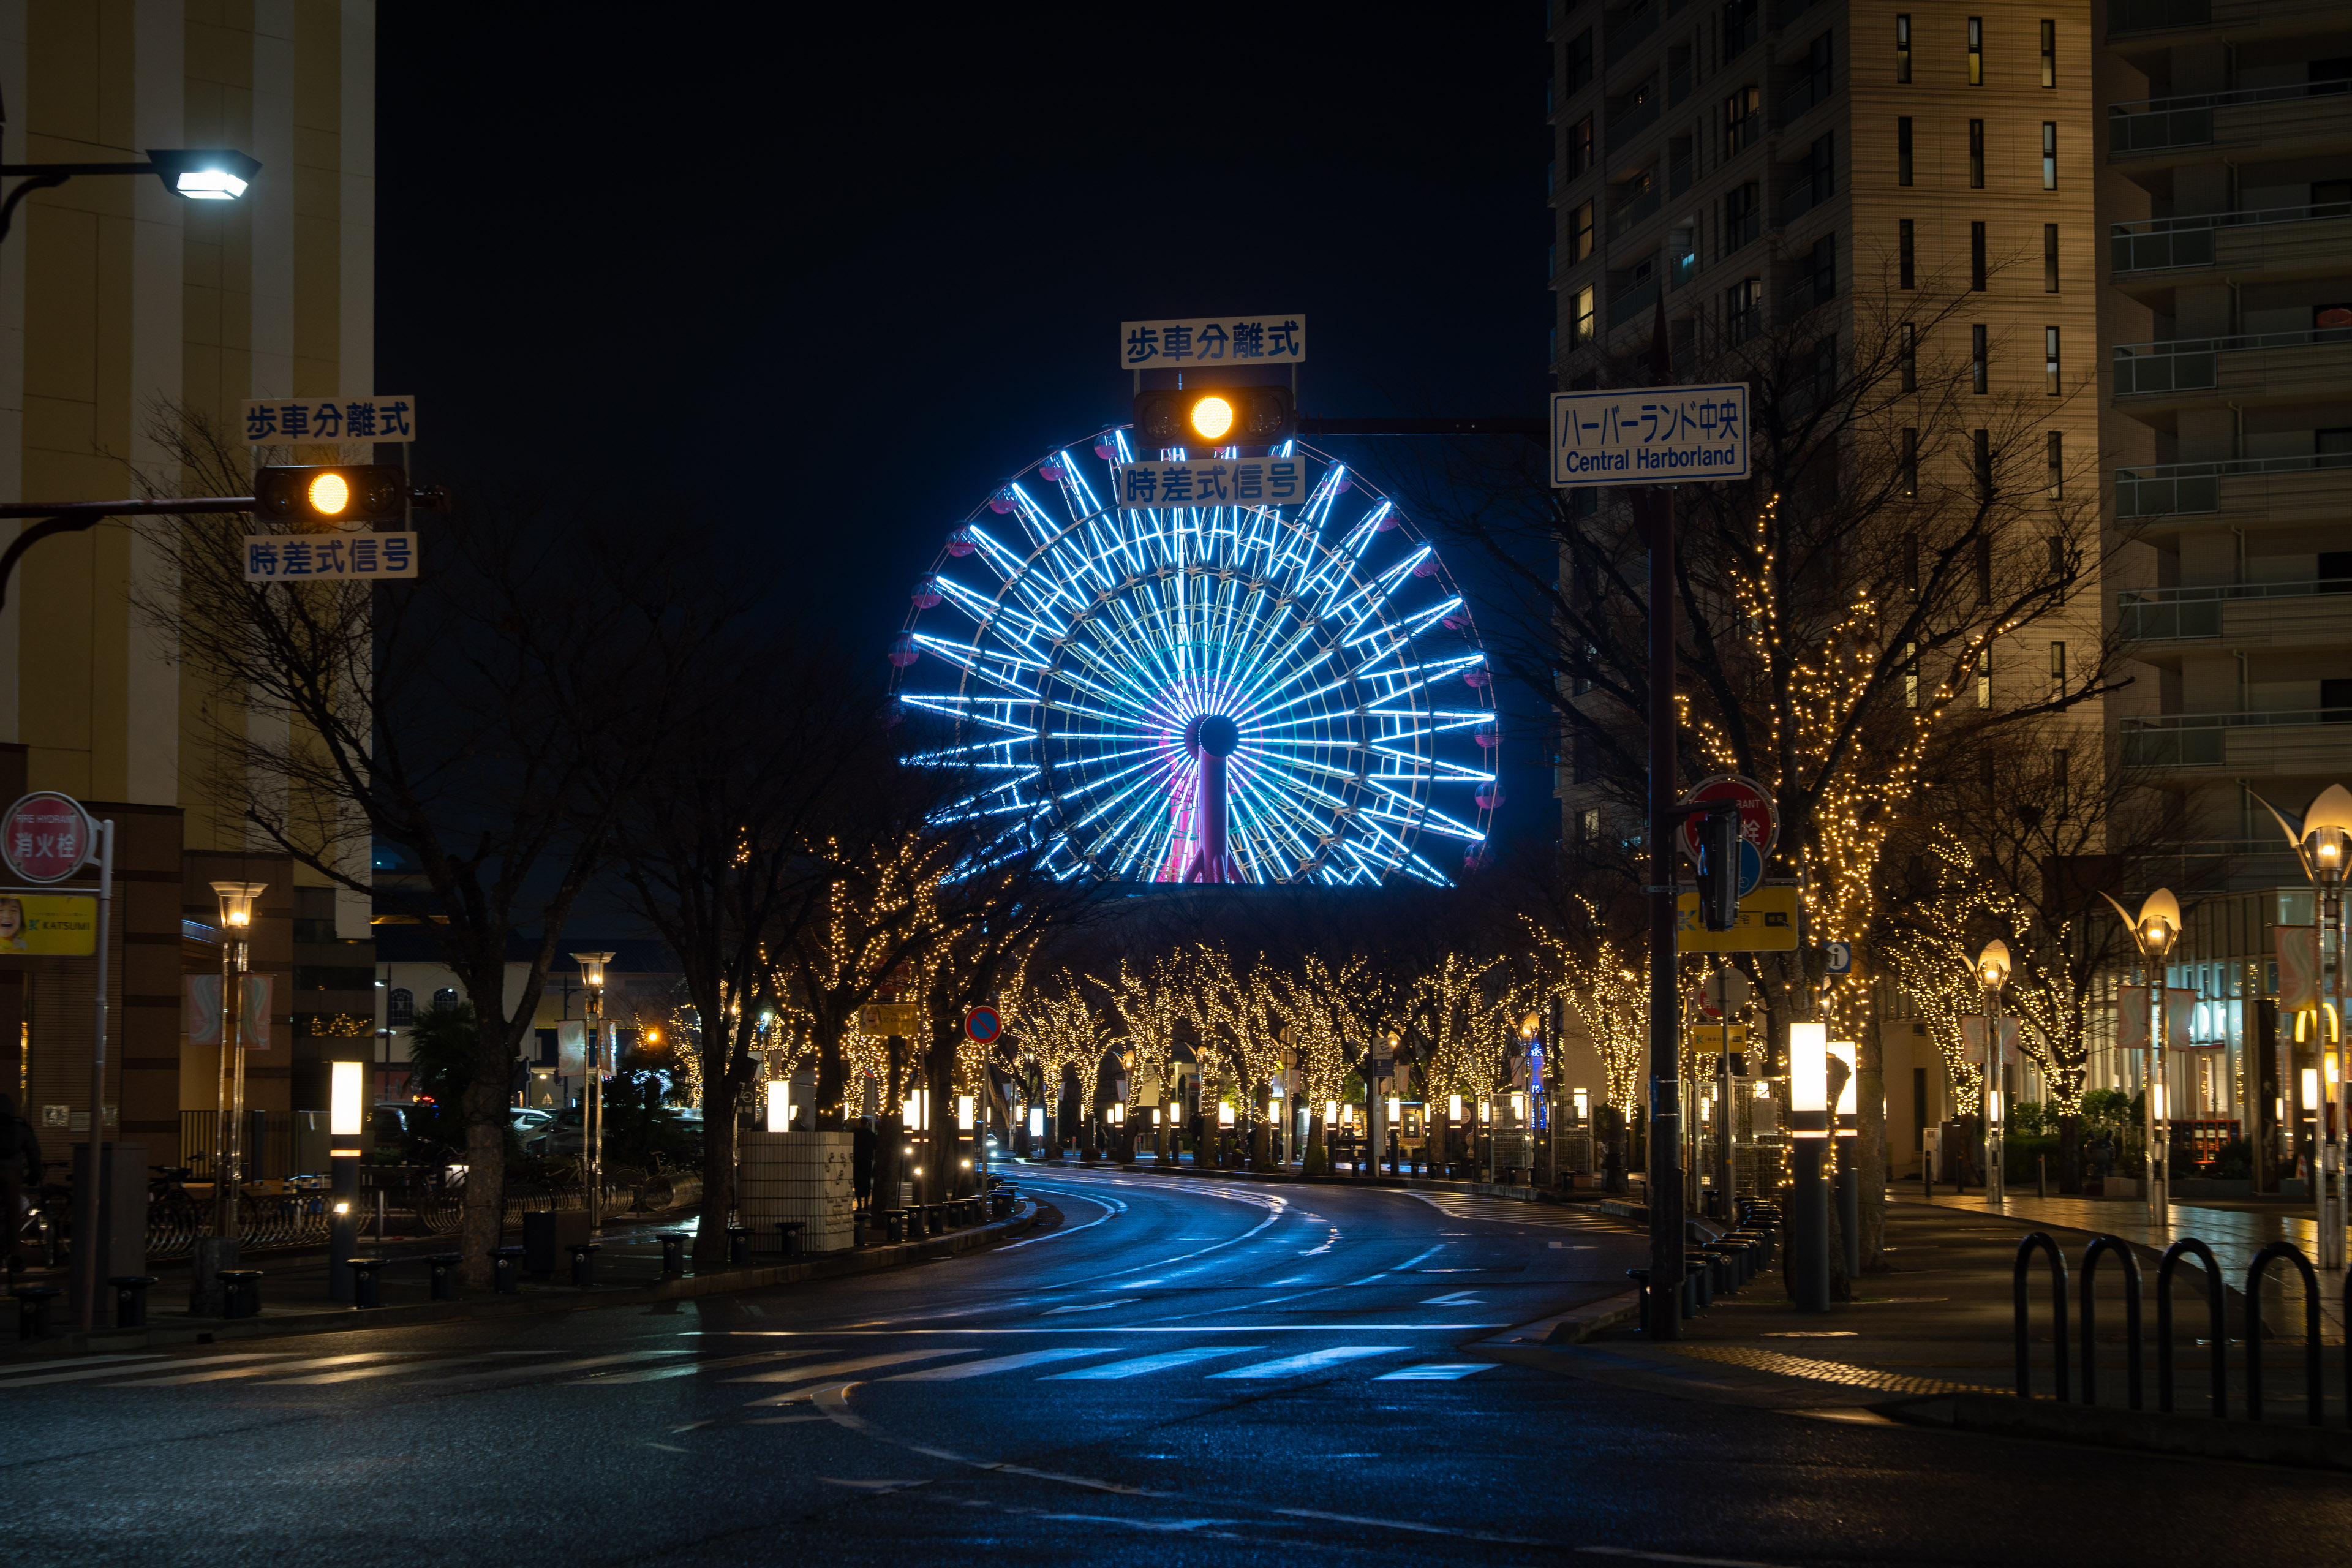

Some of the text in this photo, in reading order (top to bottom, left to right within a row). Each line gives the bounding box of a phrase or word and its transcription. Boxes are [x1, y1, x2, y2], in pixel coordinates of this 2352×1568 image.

[1127, 320, 1299, 363] 歩車分離式
[247, 401, 409, 440] 歩車分離式
[1562, 398, 1738, 447] ハーバーランド中央
[1567, 444, 1735, 473] Central Harborland
[1127, 462, 1298, 502] 時差式信号
[249, 538, 412, 575] 時差式信号
[15, 814, 78, 824] FIRE HYDRANT
[14, 832, 75, 858] 消火栓
[43, 921, 91, 930] KATSUMI
